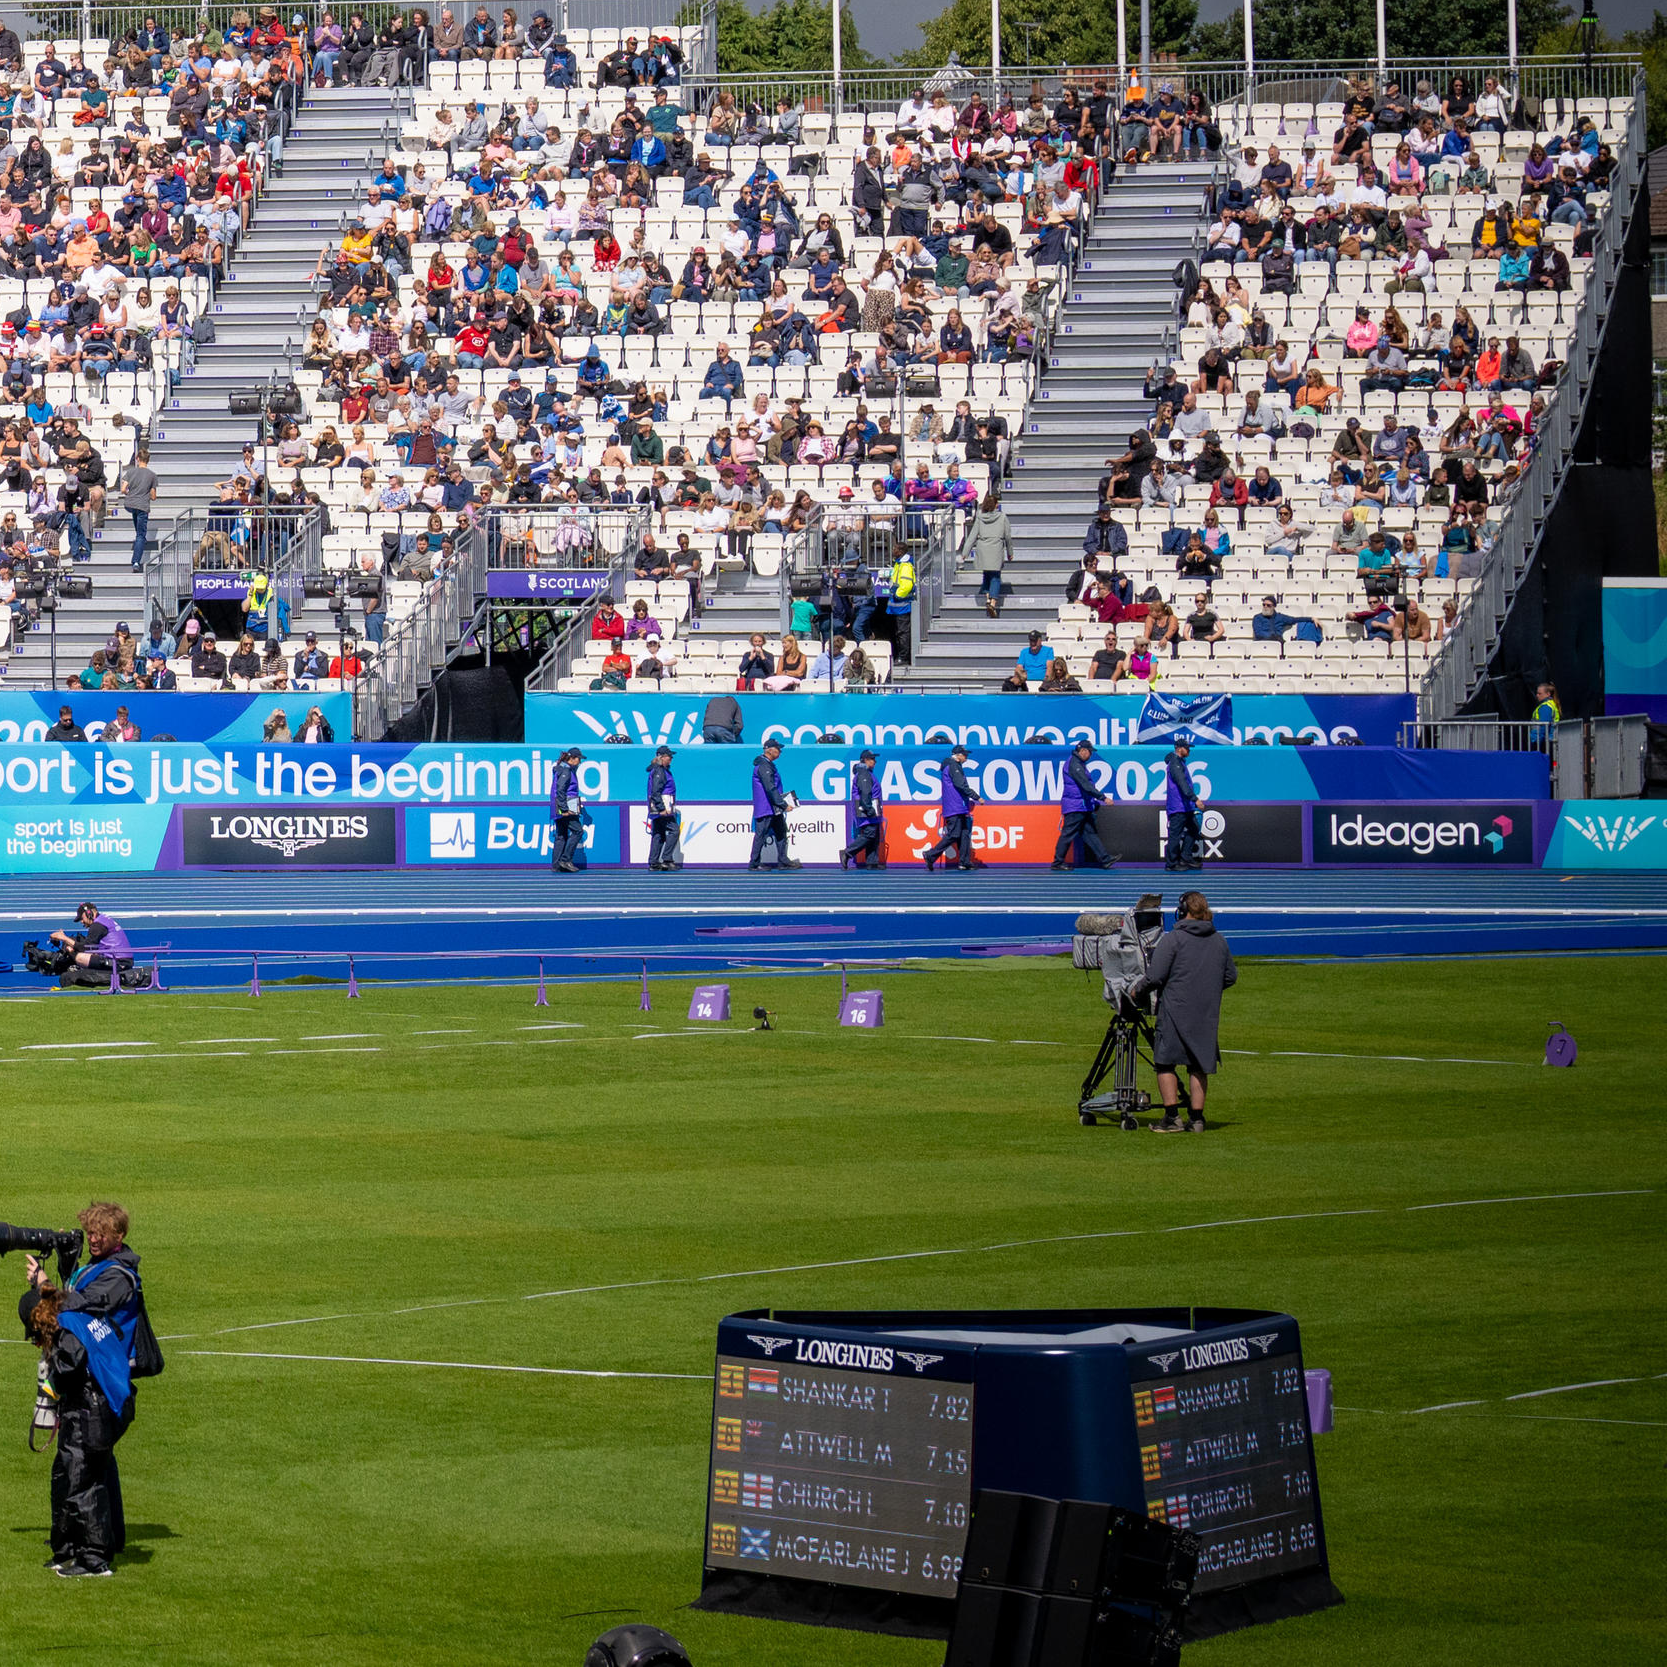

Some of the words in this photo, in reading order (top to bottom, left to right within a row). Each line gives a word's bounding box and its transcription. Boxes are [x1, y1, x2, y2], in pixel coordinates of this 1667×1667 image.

[196, 579, 232, 589] PEOPLE
[539, 577, 609, 589] SCOTLAND
[94, 751, 134, 795] is
[145, 751, 240, 805] just
[254, 751, 337, 798] the
[811, 758, 1065, 802] GASOW
[14, 819, 64, 841] sport
[69, 819, 85, 835] is
[86, 818, 124, 840] just
[210, 815, 369, 841] LONGINES
[1330, 813, 1480, 855] Ideagen
[7, 838, 37, 856] the
[41, 836, 132, 859] beginning
[696, 1003, 712, 1018] 14
[850, 1009, 867, 1024] 16
[796, 1338, 895, 1371] LONGINES
[1181, 1337, 1249, 1370] LONGINES
[782, 1377, 876, 1412] SHANKAR
[882, 1388, 893, 1412] T
[927, 1393, 969, 1421] 7.82
[1177, 1379, 1240, 1414] SHANKAR
[779, 1430, 868, 1464] ATTWELL
[874, 1443, 893, 1467] M
[927, 1445, 968, 1474] 7.15
[1185, 1432, 1243, 1467] ATTWELL
[1245, 1431, 1260, 1455] M
[778, 1481, 861, 1515] CHURCH
[867, 1491, 878, 1517] L
[925, 1498, 966, 1528] 7.10
[1191, 1484, 1246, 1520] CHURCH
[775, 1533, 897, 1574] MCFARLANE
[900, 1549, 910, 1576] J
[1197, 1531, 1275, 1576] MCFARLANE
